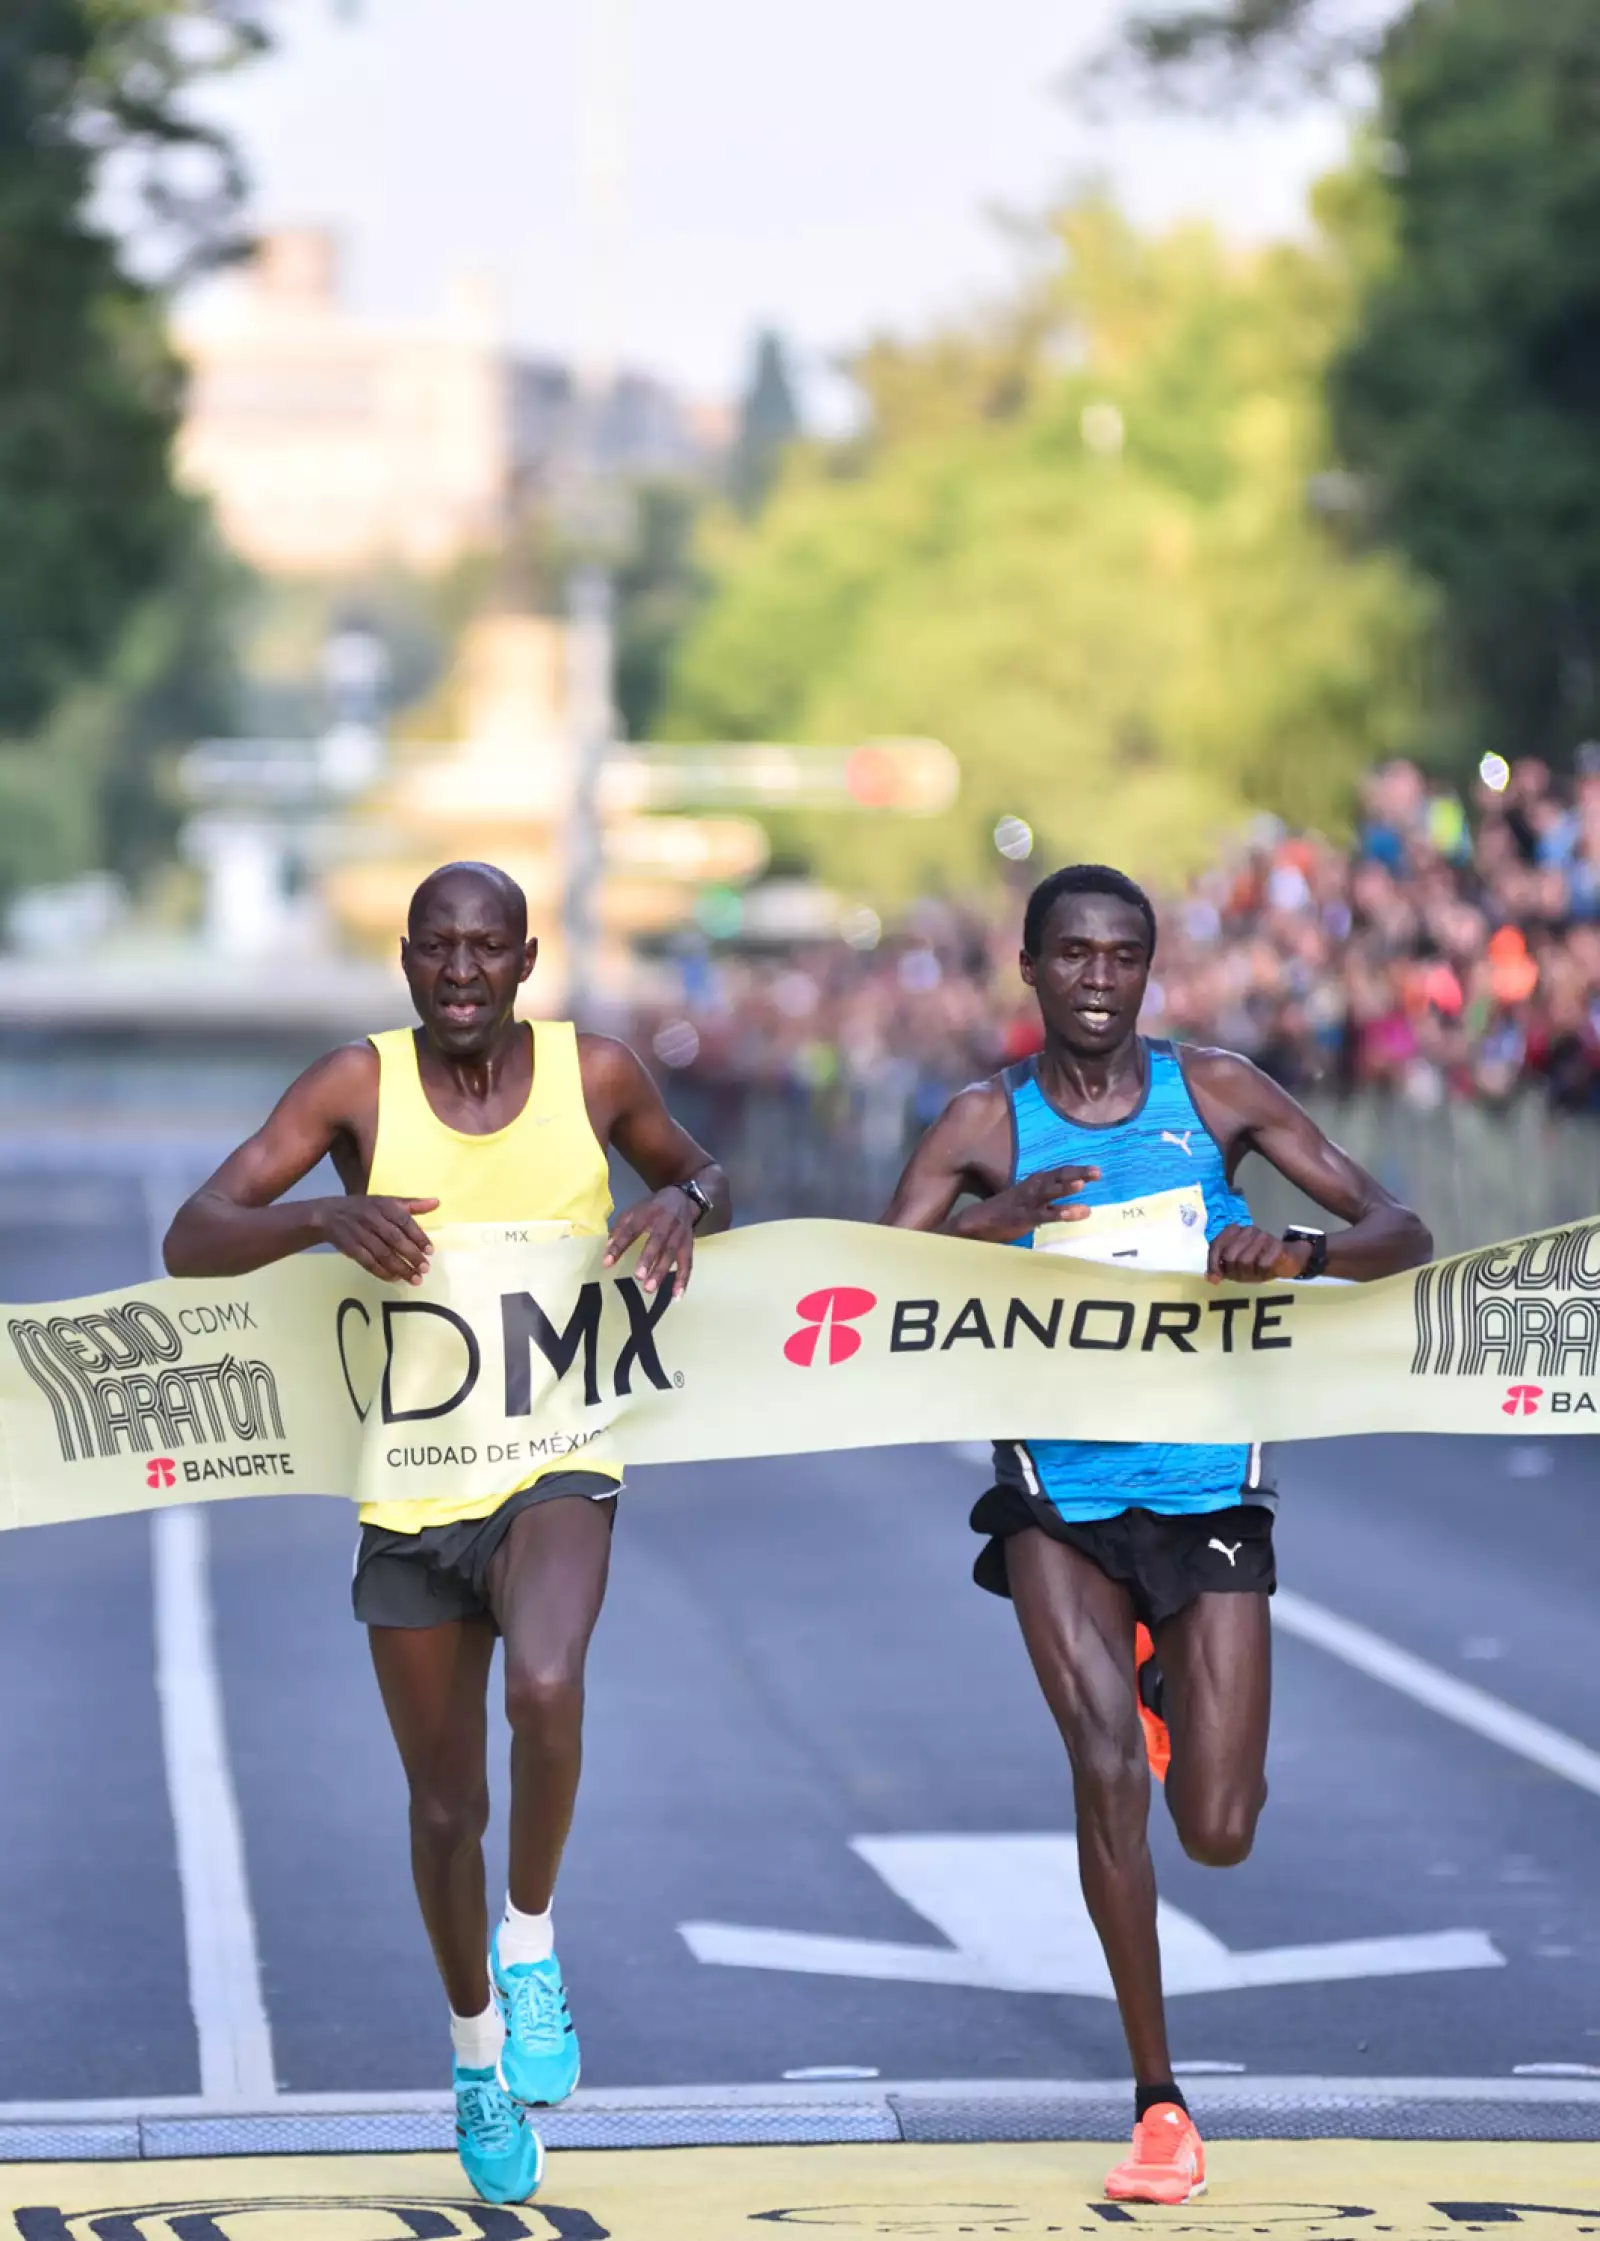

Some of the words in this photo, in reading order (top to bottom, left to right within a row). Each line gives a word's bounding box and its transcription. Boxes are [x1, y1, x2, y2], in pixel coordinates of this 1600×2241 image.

[178, 1302, 257, 1335] CDMX
[890, 1294, 1295, 1353] BANORTE
[337, 1270, 678, 1424] CDMX
[183, 1453, 294, 1483] BANORTE
[387, 1446, 478, 1467] CIUDAD
[487, 1442, 521, 1464] DE
